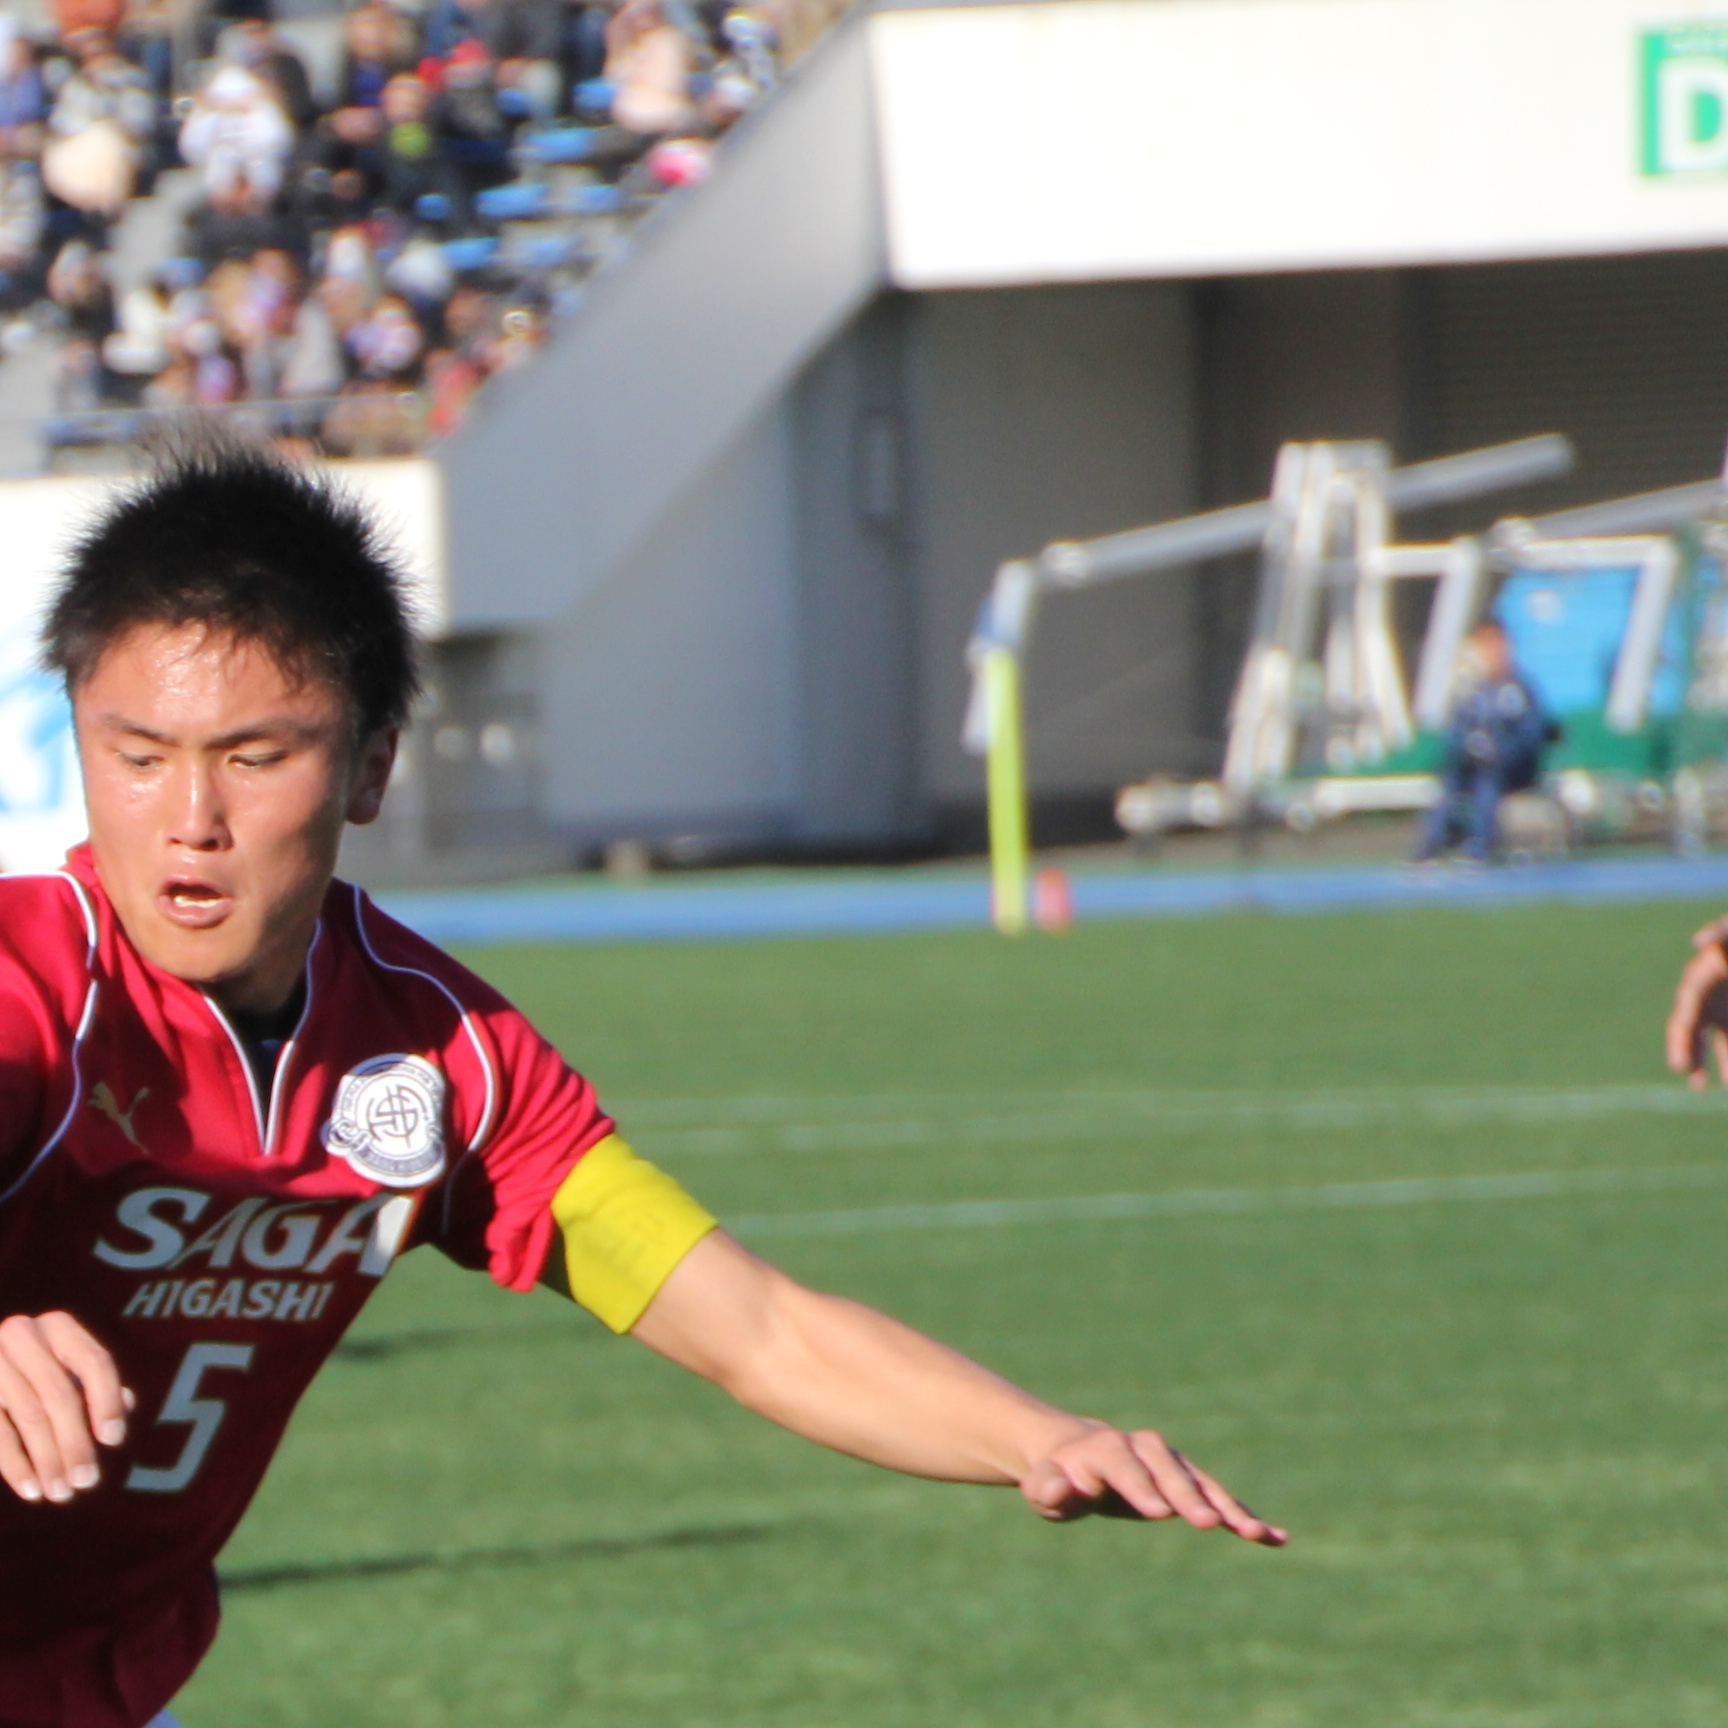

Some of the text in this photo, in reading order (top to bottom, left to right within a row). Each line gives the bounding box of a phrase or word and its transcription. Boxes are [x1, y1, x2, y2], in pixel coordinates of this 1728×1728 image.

[94, 1187, 414, 1277] SAGA
[121, 1278, 335, 1322] HIGASHI
[123, 1343, 256, 1492] 5
